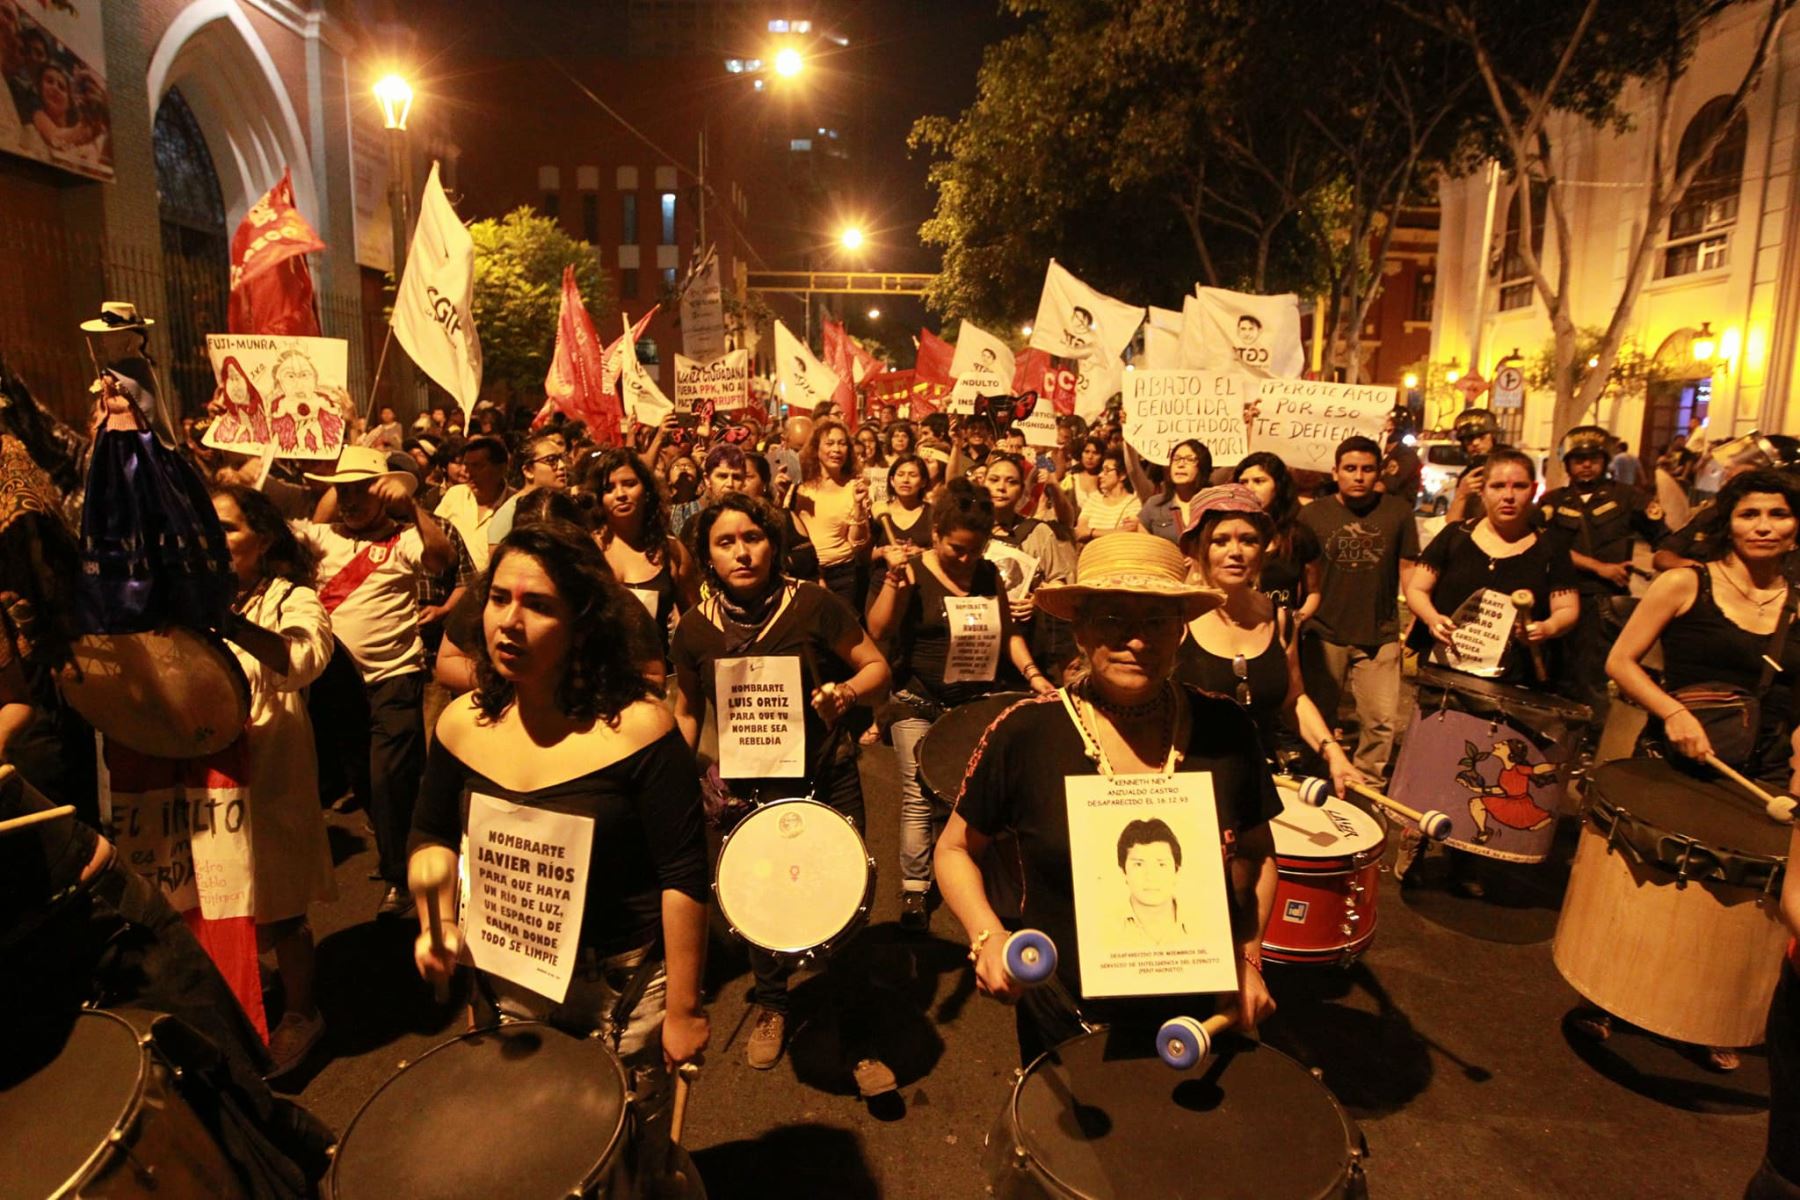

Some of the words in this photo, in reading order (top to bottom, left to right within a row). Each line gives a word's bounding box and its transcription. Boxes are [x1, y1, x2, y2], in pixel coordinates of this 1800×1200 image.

[208, 338, 277, 350] FUJI-MUNRA
[722, 382, 735, 392] NO
[1135, 376, 1202, 398] ABAJO
[1215, 376, 1236, 396] EL
[1342, 388, 1388, 404] AMO
[1137, 399, 1230, 418] GENOCIDA
[1276, 399, 1313, 415] POR
[1323, 405, 1361, 419] ESO
[1156, 418, 1241, 434] DICTADOR
[1256, 418, 1281, 437] TE
[731, 684, 785, 693] NOMBRARTE
[728, 697, 753, 709] LUIS
[756, 695, 789, 708] ORTÍZ
[729, 712, 756, 721] PARA
[758, 712, 775, 720] QUE
[777, 712, 789, 720] TU
[732, 724, 768, 733] NOMBRE
[770, 724, 788, 733] SEA
[739, 736, 782, 746] REBELDÍA
[1107, 788, 1147, 796] ANZUALDO
[1087, 798, 1143, 807] DESAPARECIDO
[488, 830, 565, 859] NOMBRARTE
[478, 847, 530, 874] JAVIER
[536, 861, 575, 883] RÍOS
[479, 867, 507, 886] PARA
[511, 878, 532, 893] QUE
[536, 884, 571, 901] HAYA
[484, 883, 497, 897] UN
[521, 895, 535, 911] DE
[538, 900, 565, 918] LUZ,
[484, 899, 498, 914] UN
[501, 905, 543, 928] ESPACIO
[546, 919, 563, 933] DE
[485, 915, 520, 936] CALMA
[522, 928, 558, 949] DONDE
[481, 929, 506, 948] TODO
[508, 939, 522, 953] SE
[525, 945, 560, 967] LIMPIE
